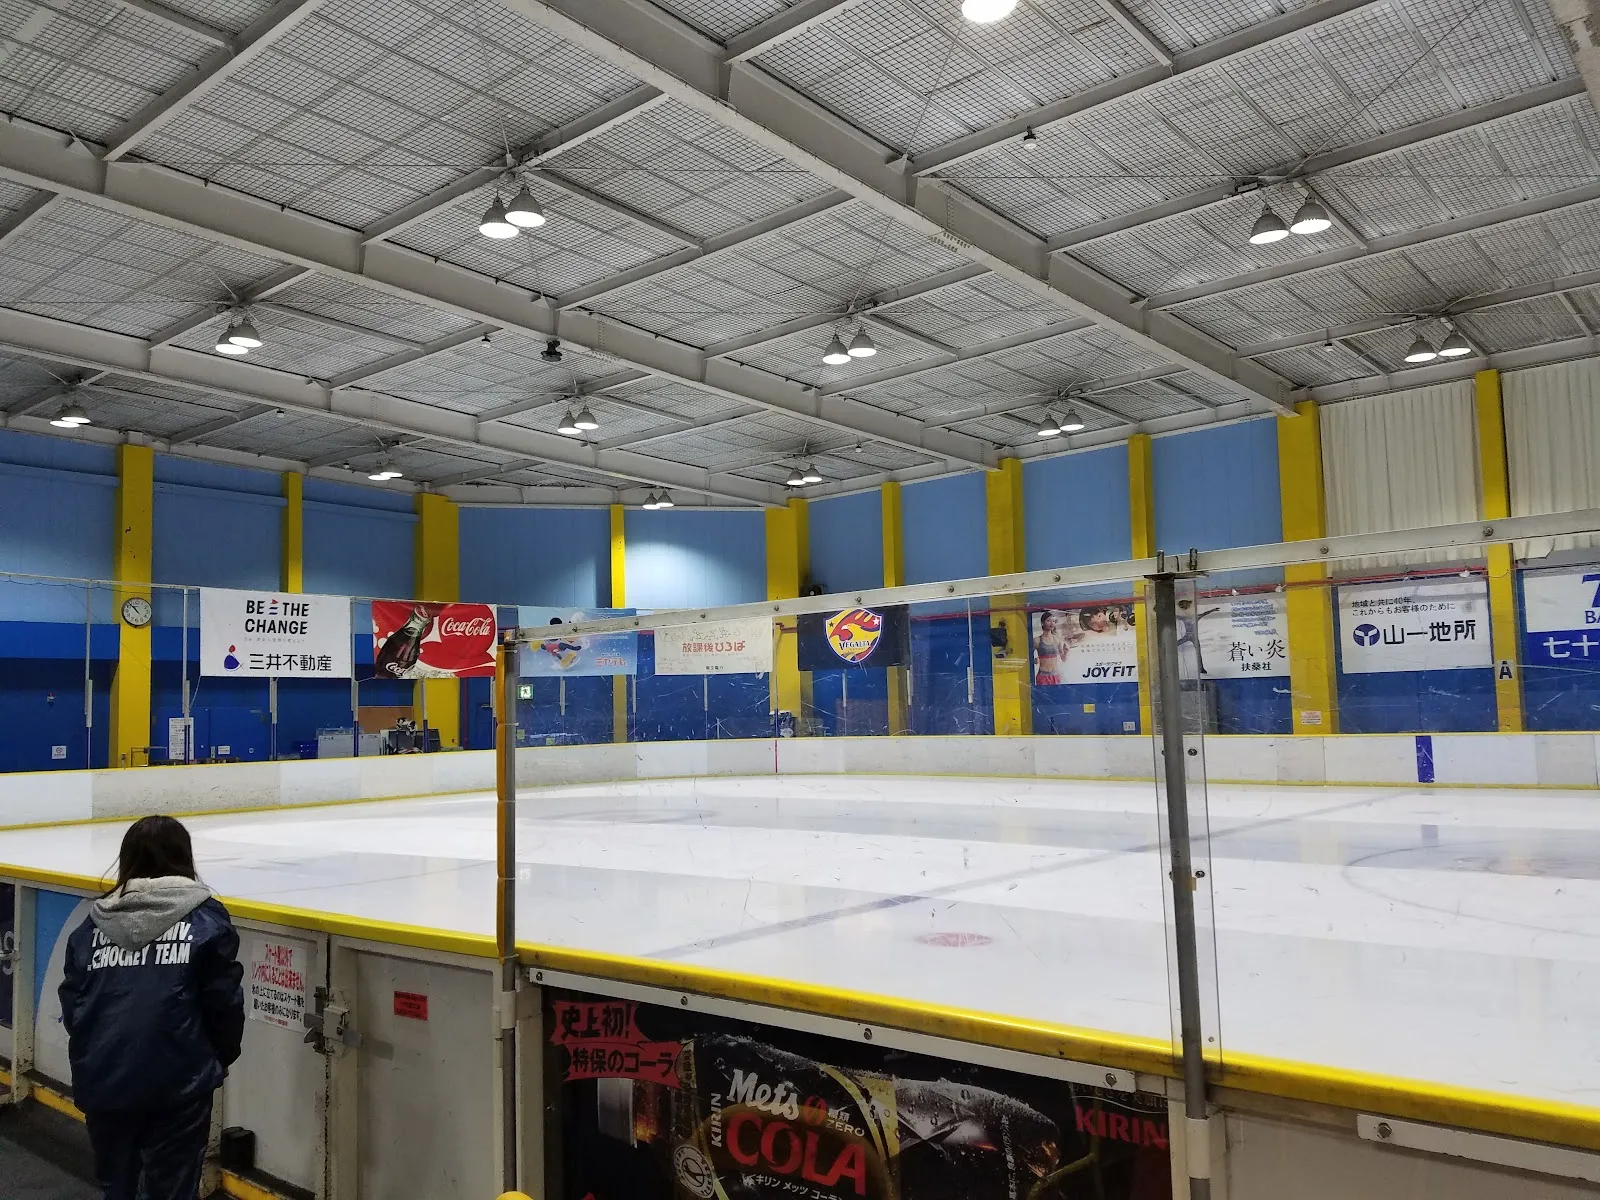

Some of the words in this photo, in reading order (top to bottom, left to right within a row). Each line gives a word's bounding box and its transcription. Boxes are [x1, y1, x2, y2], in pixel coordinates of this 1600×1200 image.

[246, 600, 265, 614] BE
[283, 602, 309, 616] THE
[1352, 603, 1456, 617] これからもお客様のために
[245, 618, 308, 634] CHANGE
[441, 617, 492, 637] Coca-Cola
[1383, 619, 1476, 645] 山一地所
[682, 641, 746, 653] 放課後ひろば
[838, 640, 870, 650] VEGALTA
[1228, 639, 1286, 661] 蒼い炎
[1543, 634, 1600, 658] 七十
[249, 653, 332, 671] 三井不動産
[1082, 666, 1111, 678] JOY
[1112, 665, 1136, 677] FIT
[1241, 661, 1272, 671] 扶桑社
[1499, 660, 1513, 680] A
[155, 921, 194, 942] NIV.
[155, 943, 191, 965] TEAM
[572, 1046, 674, 1078] 特保のコーラ
[726, 1068, 800, 1121] Mets
[711, 1092, 722, 1148] KIRIN
[825, 1118, 865, 1138] ZERO
[1076, 1104, 1169, 1149] KIRIN
[726, 1111, 866, 1196] COLA
[755, 1174, 781, 1188] キリン
[783, 1181, 809, 1195] メッツ
